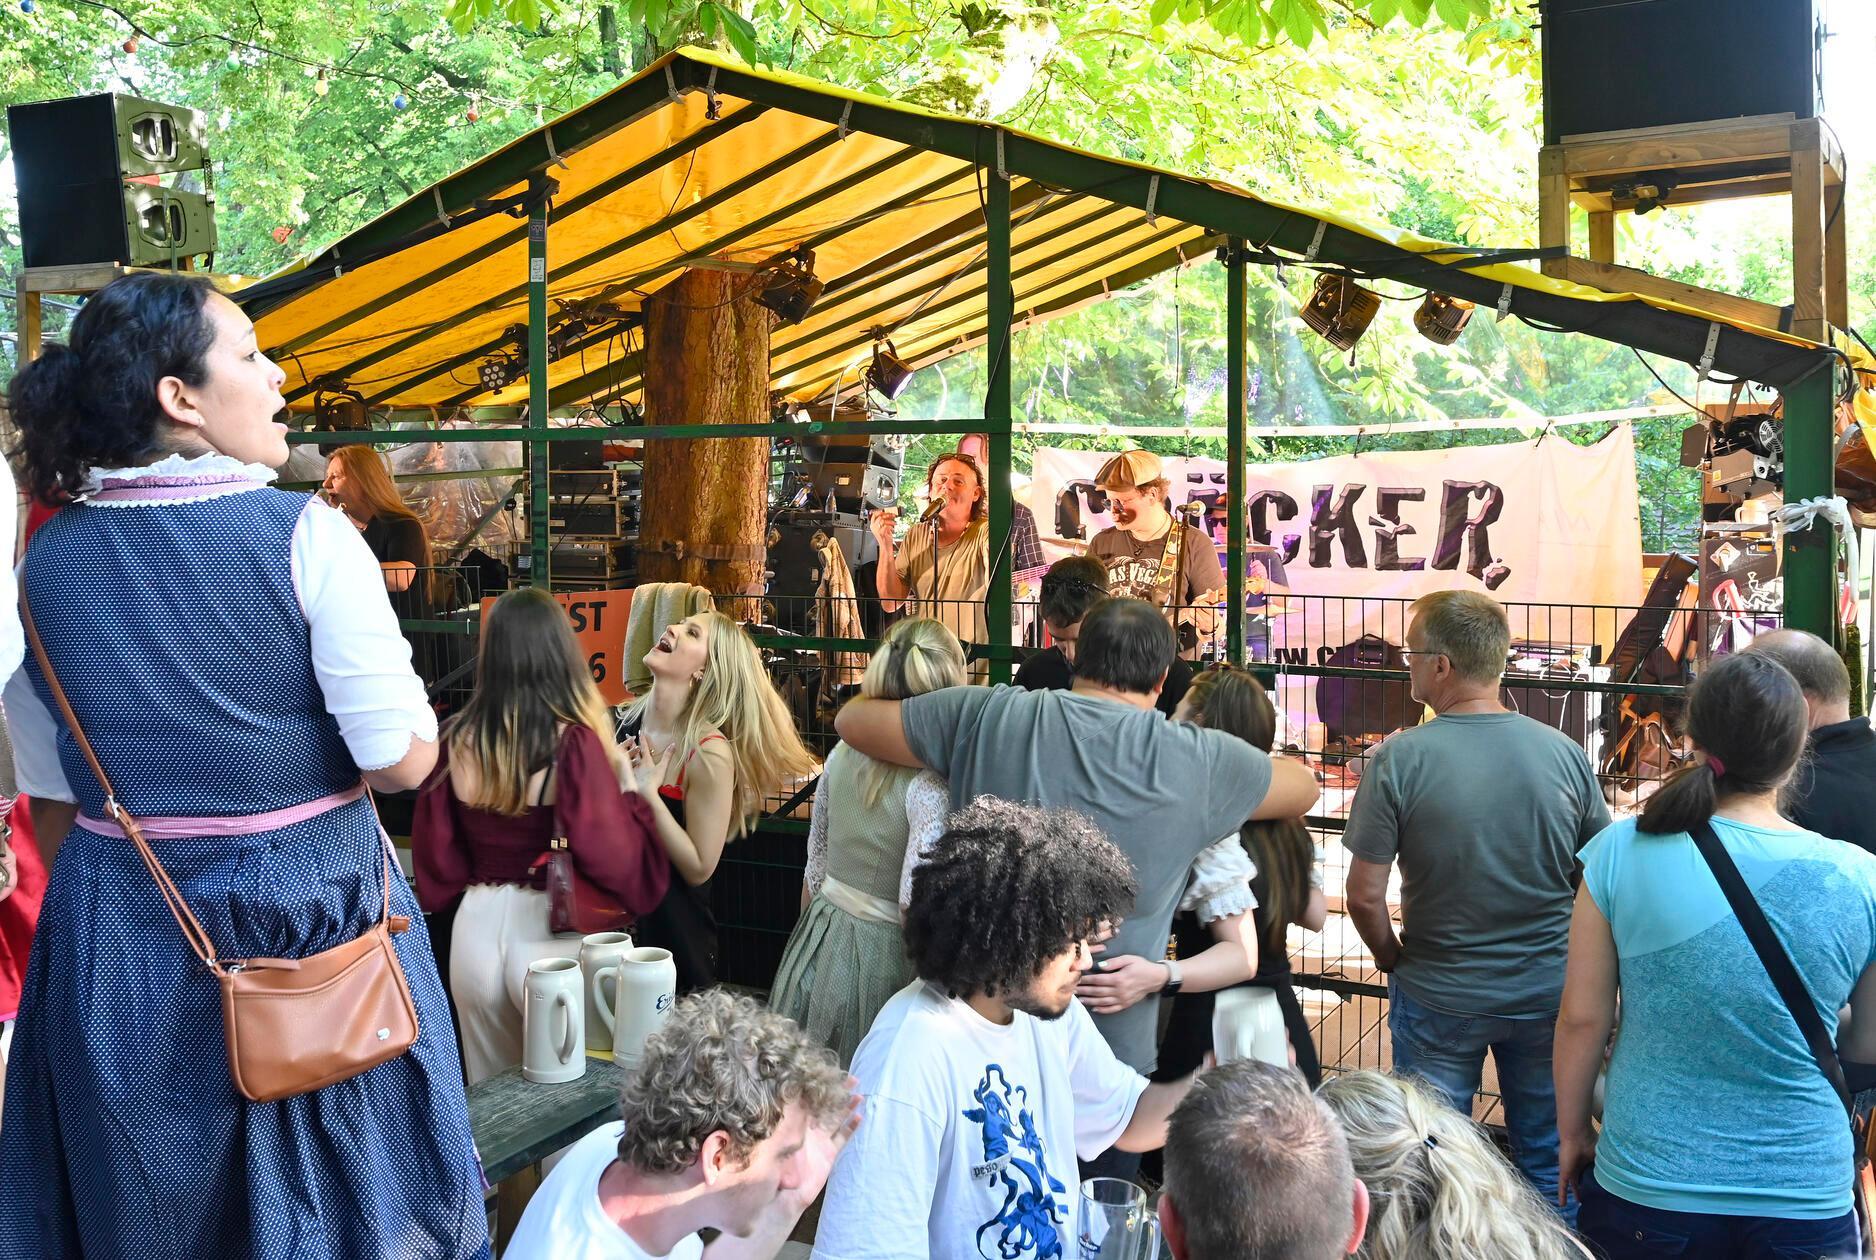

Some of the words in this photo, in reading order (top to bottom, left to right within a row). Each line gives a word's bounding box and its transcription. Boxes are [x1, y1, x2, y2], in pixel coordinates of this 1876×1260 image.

[1109, 565, 1127, 585] AS
[1129, 562, 1158, 587] VEG
[561, 601, 607, 633] ST
